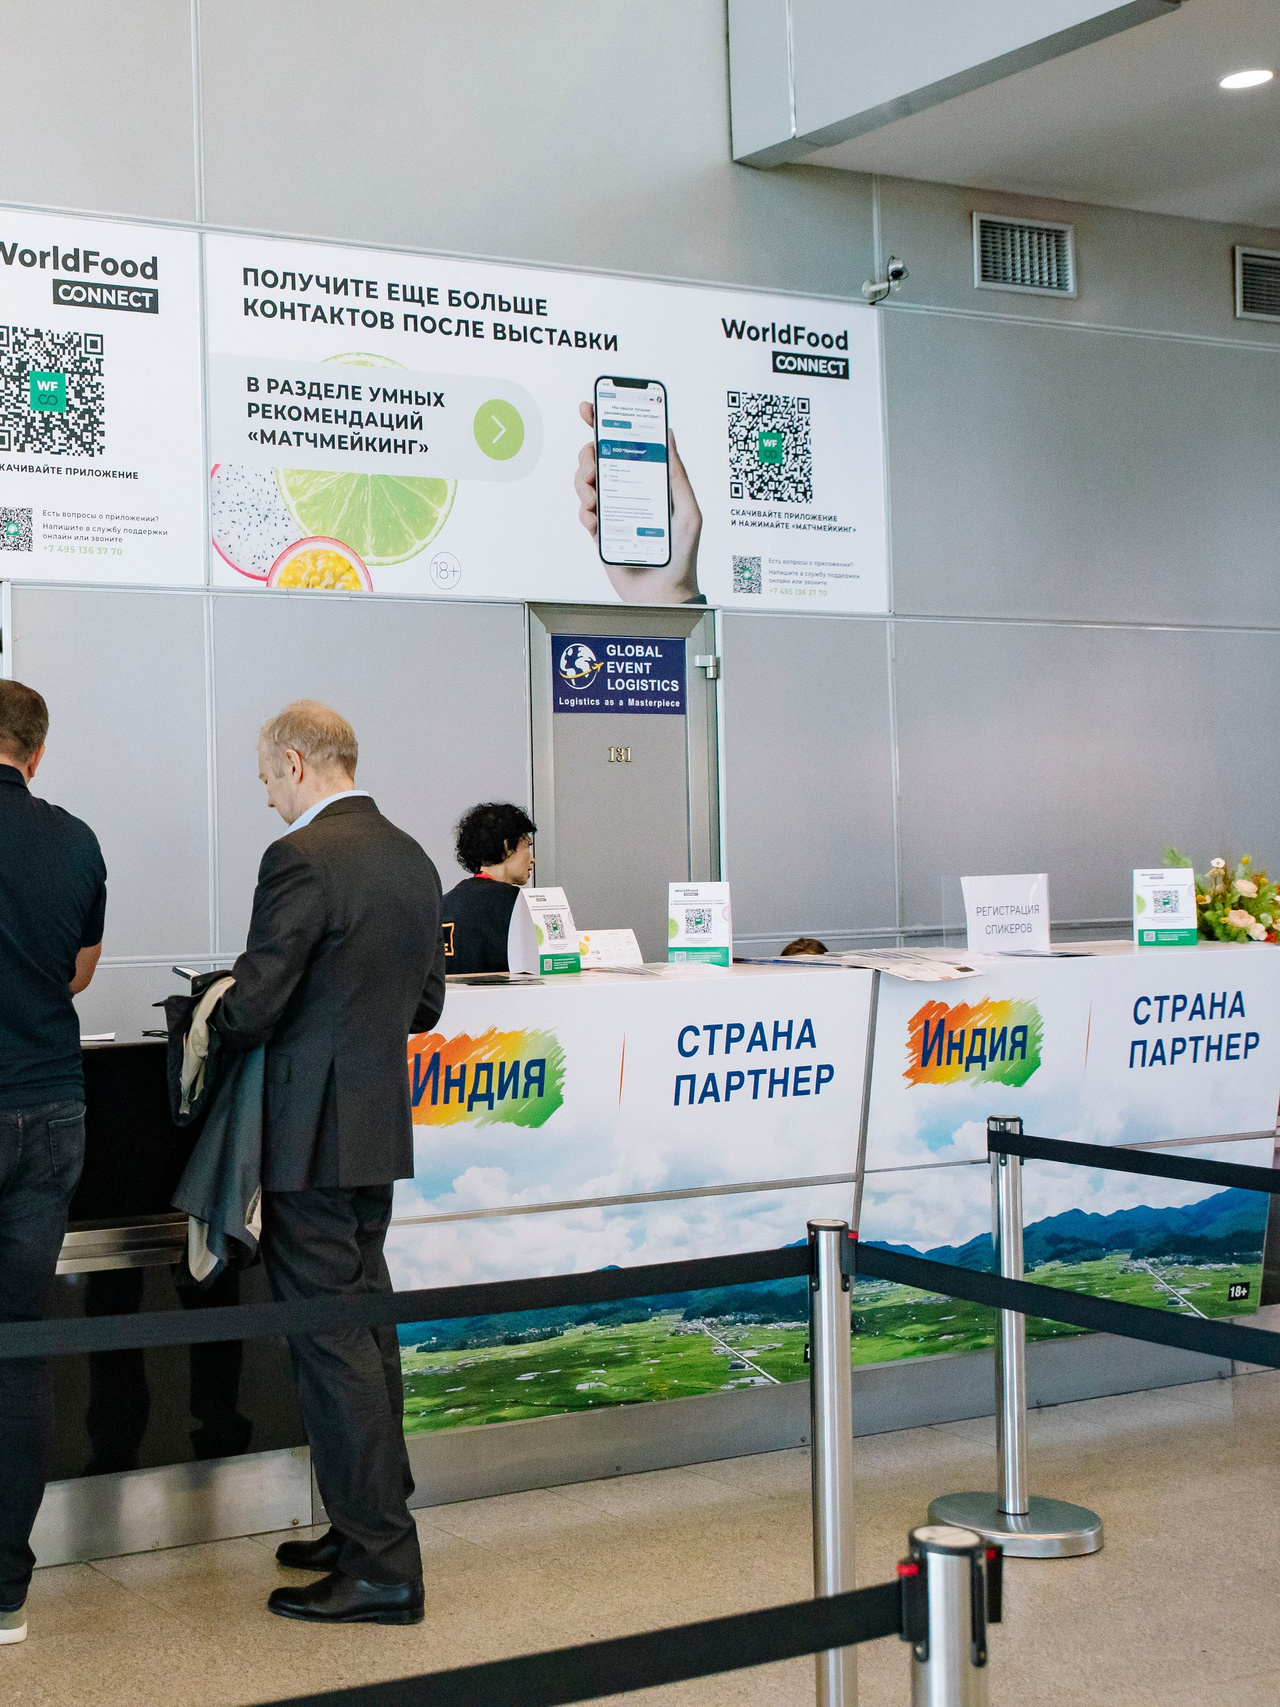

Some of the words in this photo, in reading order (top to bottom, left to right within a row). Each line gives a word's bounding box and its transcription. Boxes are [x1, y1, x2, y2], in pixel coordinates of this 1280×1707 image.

[58, 284, 154, 309] CONNECT
[243, 267, 378, 299] ПОЛУЧИТЕ
[388, 282, 438, 306] ЕЩЕ
[449, 289, 547, 316] БОЛЬШЕ
[243, 297, 394, 330] КОНТАКТОВ
[403, 313, 484, 339] ПОСЛЕ
[493, 323, 618, 352] ВЫСТАВКИ
[721, 318, 848, 351] WorldFood
[776, 355, 845, 376] CONNECT
[37, 380, 58, 392] WF
[247, 376, 259, 393] В
[266, 378, 362, 401] РАЗДЕЛЕ
[369, 386, 445, 408] УМНЫХ
[247, 402, 423, 431] РЕКОМЕНДАЦИЙ
[248, 428, 428, 455] «МАТЧМЕЙКИНГ»
[763, 438, 778, 448] WF
[65, 468, 139, 480] ПРИЛОЖЕНИЕ
[42, 509, 60, 518] Есть
[62, 512, 96, 521] вопросы
[105, 514, 159, 523] приложении?
[731, 509, 782, 519] СКАЧИВАЙТЕ
[785, 512, 838, 522] ПРИЛОЖЕНИЕ
[42, 523, 84, 532] Напишите
[92, 526, 121, 535] службу
[123, 528, 168, 536] поддержки
[739, 520, 789, 530] НАЖИМАЙТЕ
[792, 524, 857, 533] «МАТЧМЕЙКИНГ»
[42, 533, 71, 541] онлайн
[44, 545, 54, 553] +7
[58, 546, 75, 554] 495
[79, 546, 94, 555] 136
[97, 547, 108, 555] 37
[111, 548, 123, 556] 70
[433, 560, 459, 581] 18+
[606, 644, 663, 658] GLOBAL
[606, 661, 652, 675] EVENT
[607, 678, 679, 692] LOGISTICS
[559, 697, 600, 707] Logistics
[628, 698, 680, 708] Masterpiece
[608, 746, 633, 763] 131
[976, 904, 1040, 917] РЕГИСТРАЦИЯ
[985, 923, 1033, 935] СПИКЕРОВ
[1133, 990, 1246, 1026] СТРАНА
[678, 1017, 818, 1058] СТРАНА
[921, 1020, 1028, 1072] Индия
[1129, 1031, 1261, 1070] ПАРТНЕР
[411, 1054, 546, 1114] Индия
[674, 1064, 835, 1107] ПАРТНЕР
[1229, 1286, 1249, 1297] 18+
